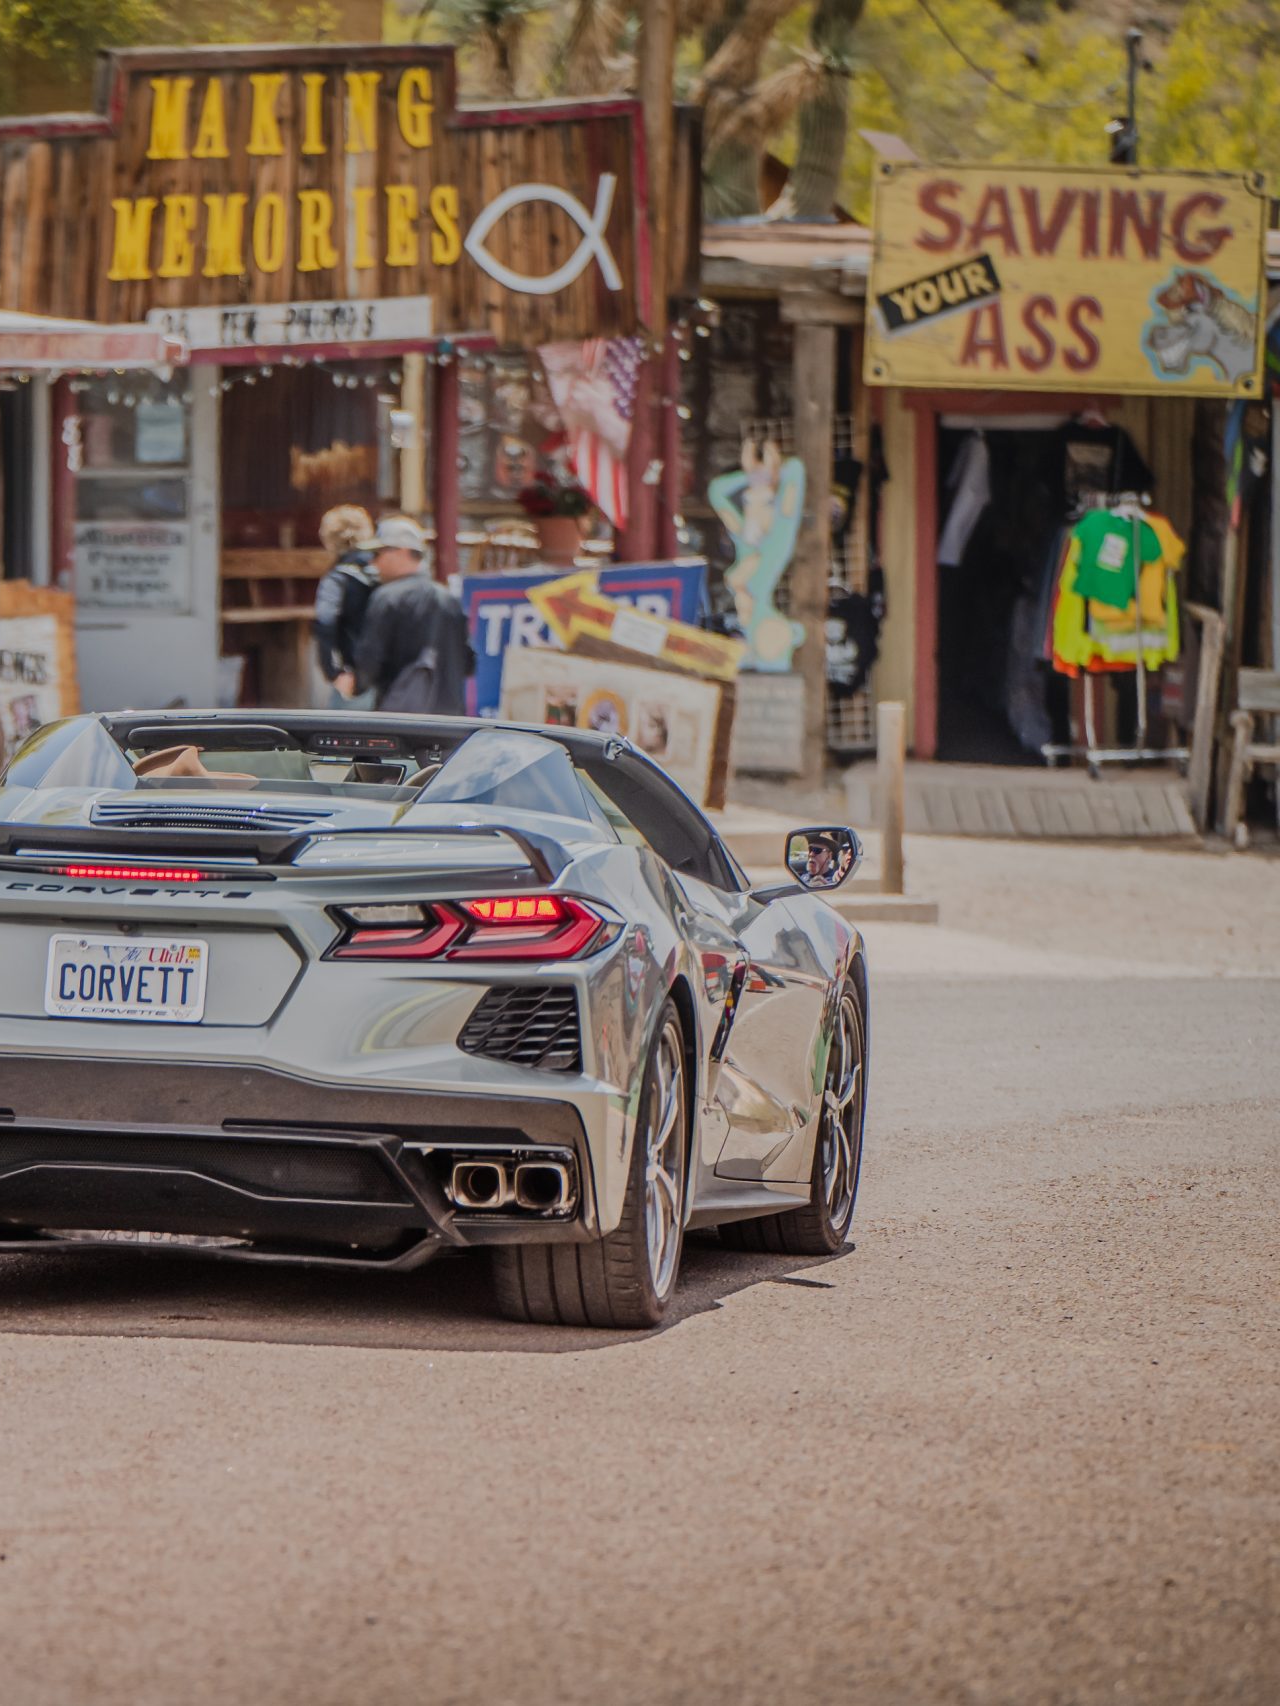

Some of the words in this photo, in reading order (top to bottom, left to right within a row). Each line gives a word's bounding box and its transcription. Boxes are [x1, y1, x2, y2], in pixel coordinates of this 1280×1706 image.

[145, 66, 434, 161] MAKING
[106, 184, 462, 282] MEMORIES
[914, 177, 1234, 264] SAVING
[890, 260, 996, 322] YOUR
[960, 292, 1104, 373] ASS
[5, 881, 254, 899] CORVETTE
[58, 962, 195, 1005] CORVETT
[80, 1006, 168, 1017] CORVETTE
